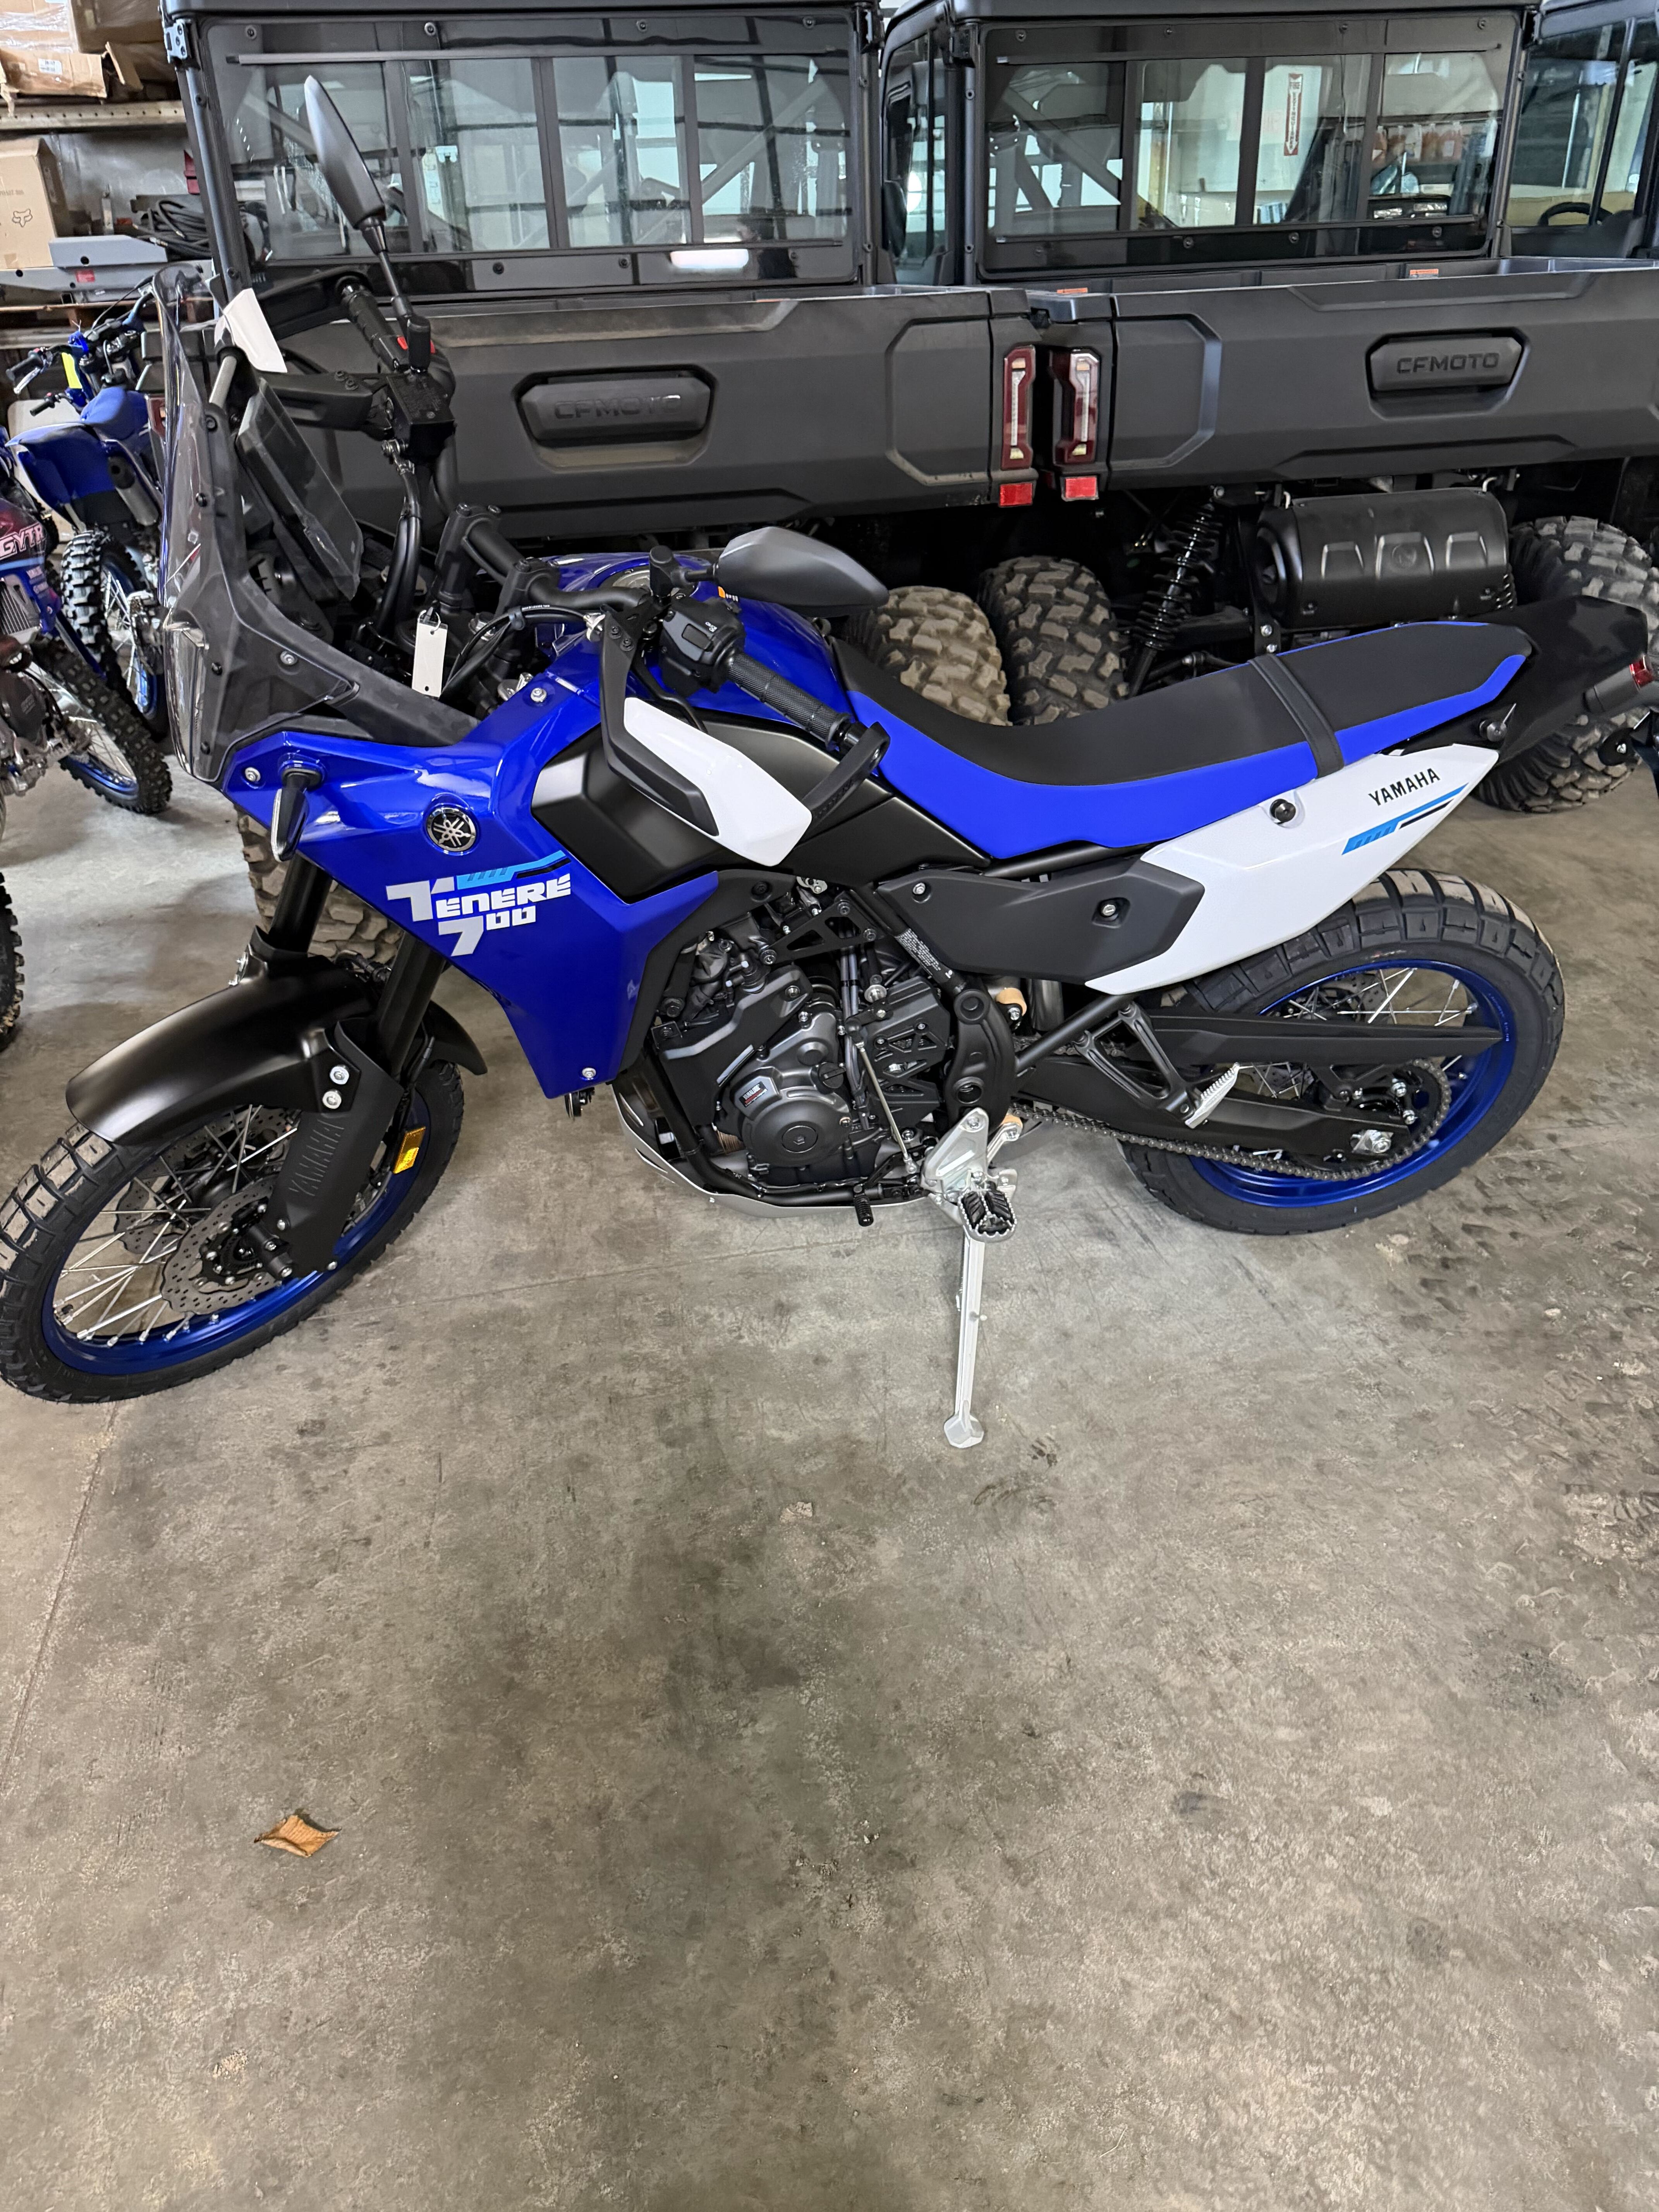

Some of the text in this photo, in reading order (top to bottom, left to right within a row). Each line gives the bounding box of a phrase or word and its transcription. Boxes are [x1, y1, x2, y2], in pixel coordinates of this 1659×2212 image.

[1396, 352, 1499, 374] CFMOTO
[1368, 768, 1441, 806] YAMAHA
[438, 906, 536, 957] 700
[289, 1119, 345, 1196] YAMAHA
